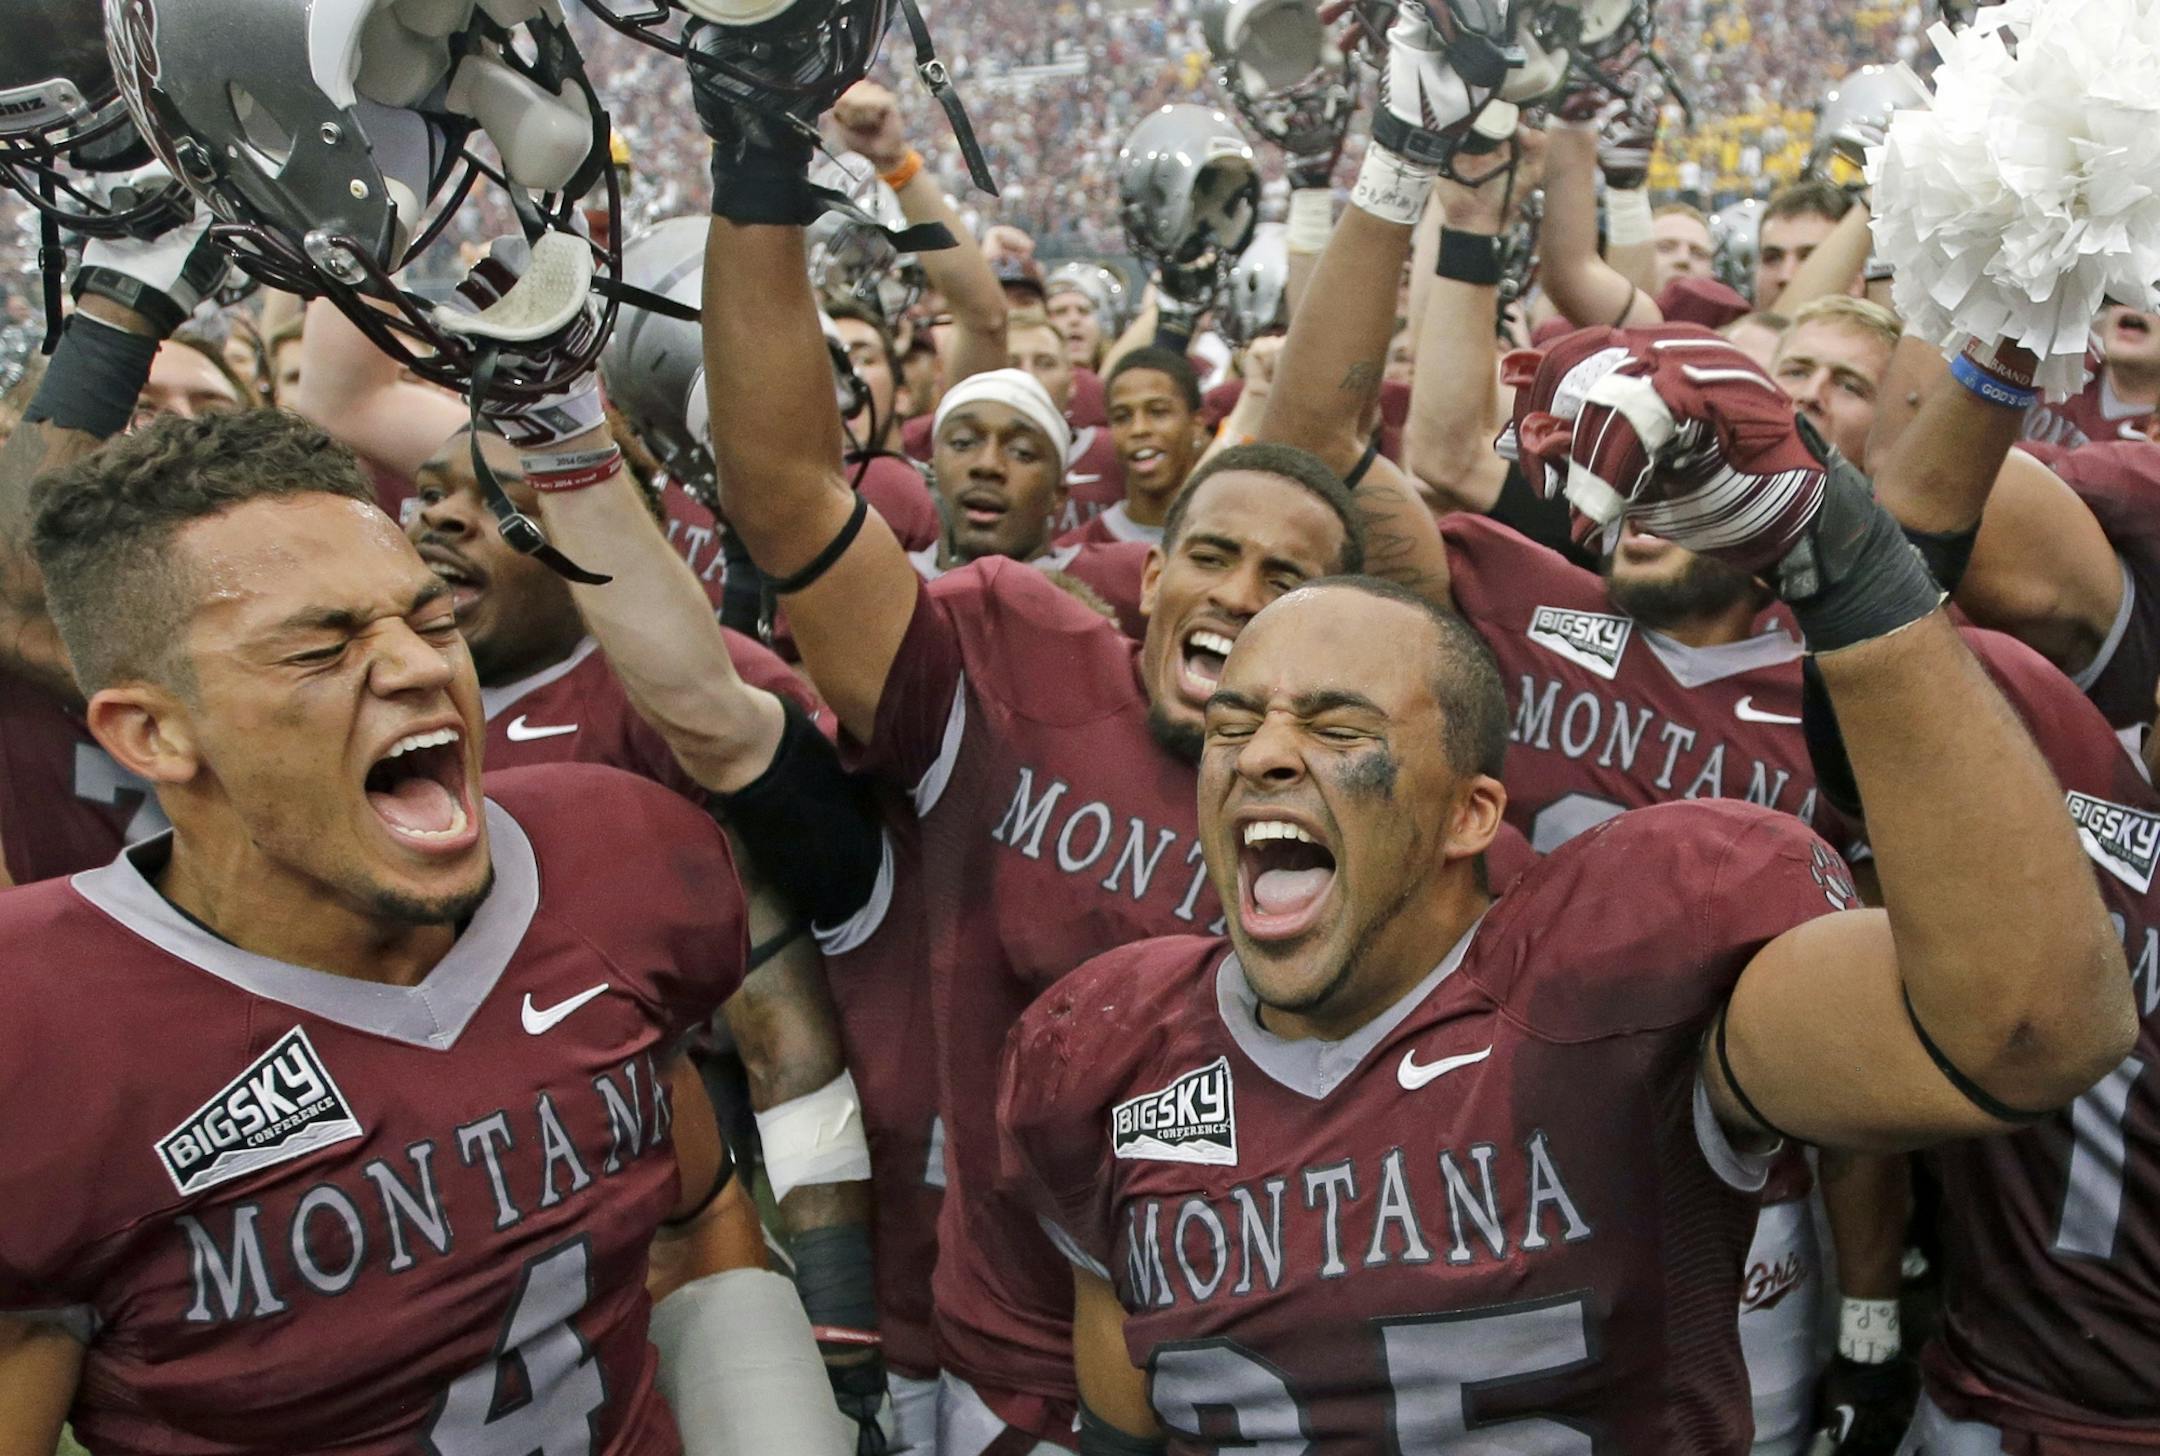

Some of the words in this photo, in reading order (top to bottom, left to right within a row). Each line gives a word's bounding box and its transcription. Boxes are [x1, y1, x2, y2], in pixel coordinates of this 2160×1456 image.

[990, 766, 1227, 937] MONT
[245, 1095, 336, 1148] CONFERENCE
[1156, 1123, 1228, 1140] CONFERENCE
[1126, 1130, 1594, 1307] MONTANA
[424, 1236, 605, 1456] 4
